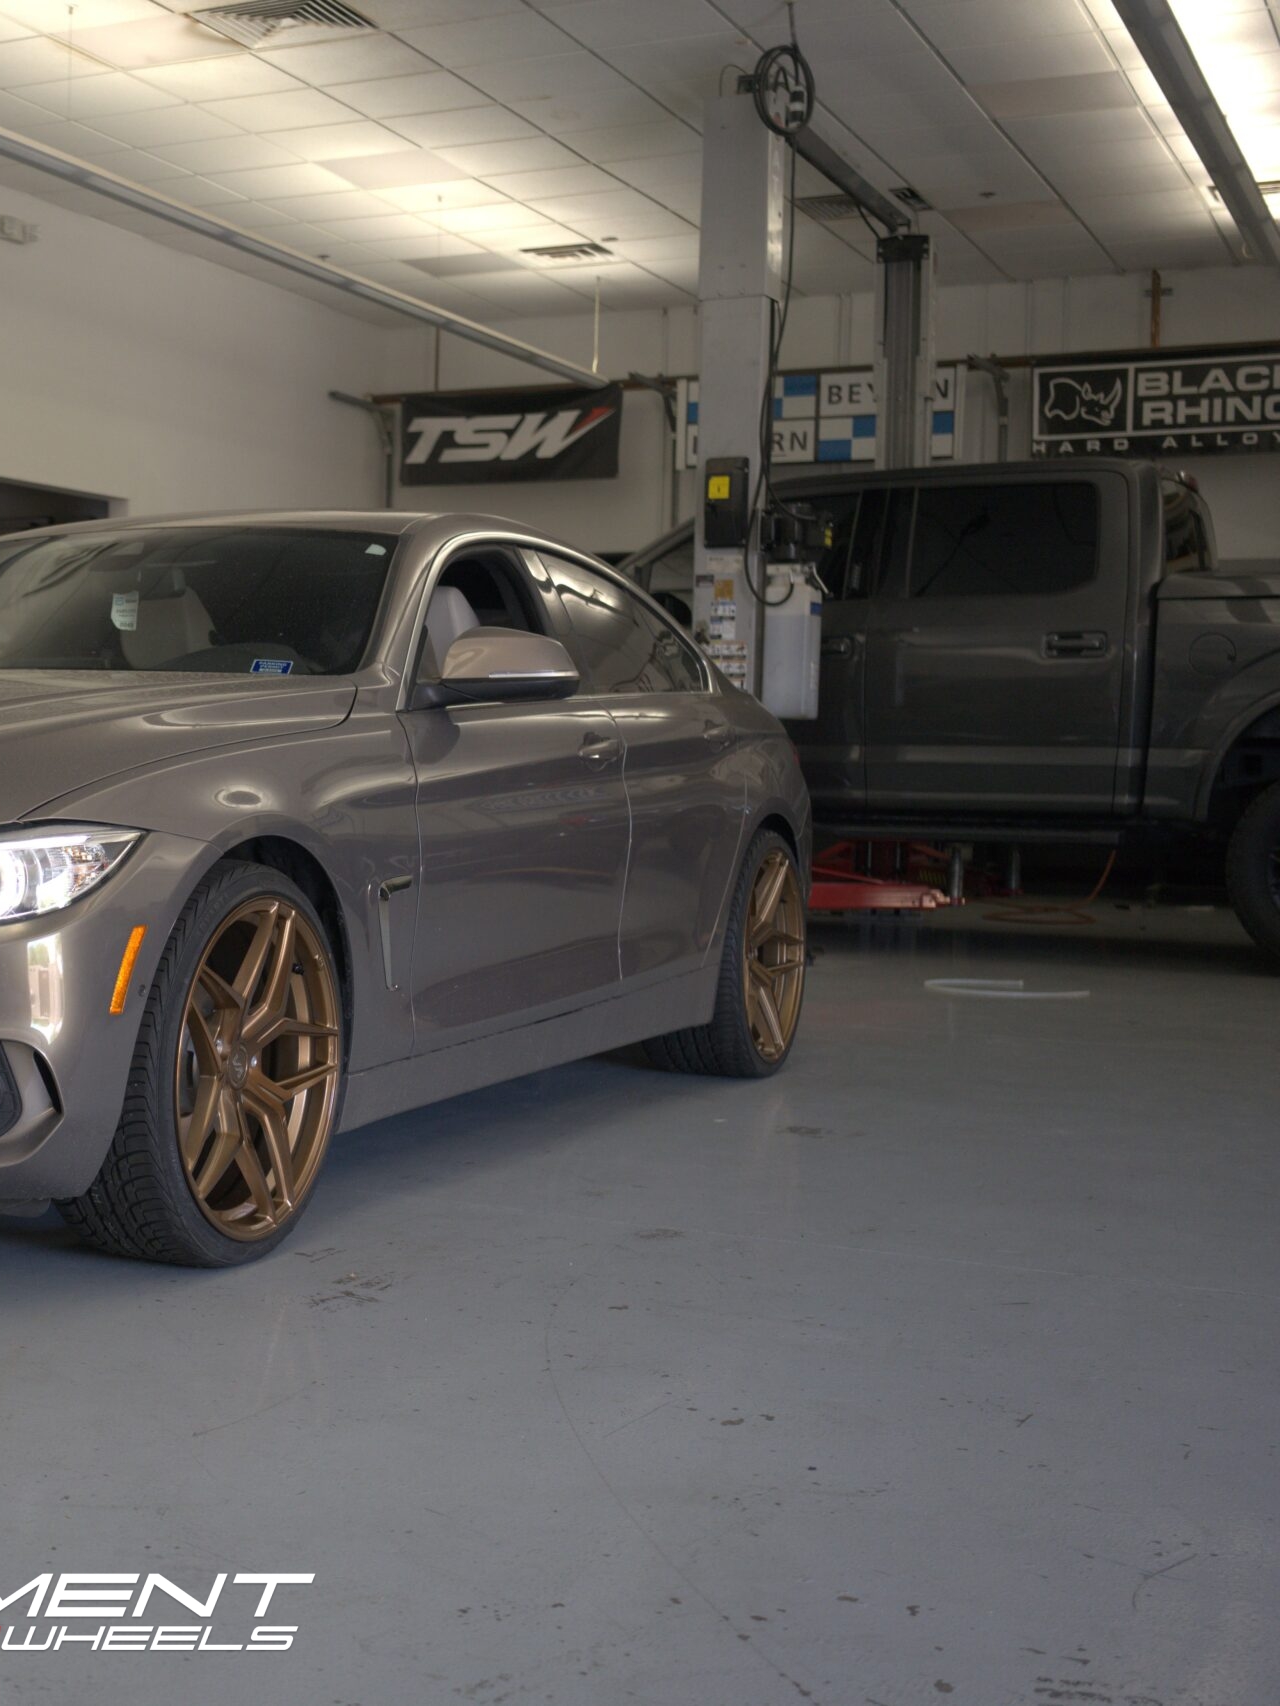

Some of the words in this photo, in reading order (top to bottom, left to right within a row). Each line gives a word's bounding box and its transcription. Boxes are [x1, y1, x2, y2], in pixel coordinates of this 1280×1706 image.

[1137, 364, 1280, 398] BLAC
[405, 407, 616, 464] TSW
[1032, 438, 1129, 454] HARD
